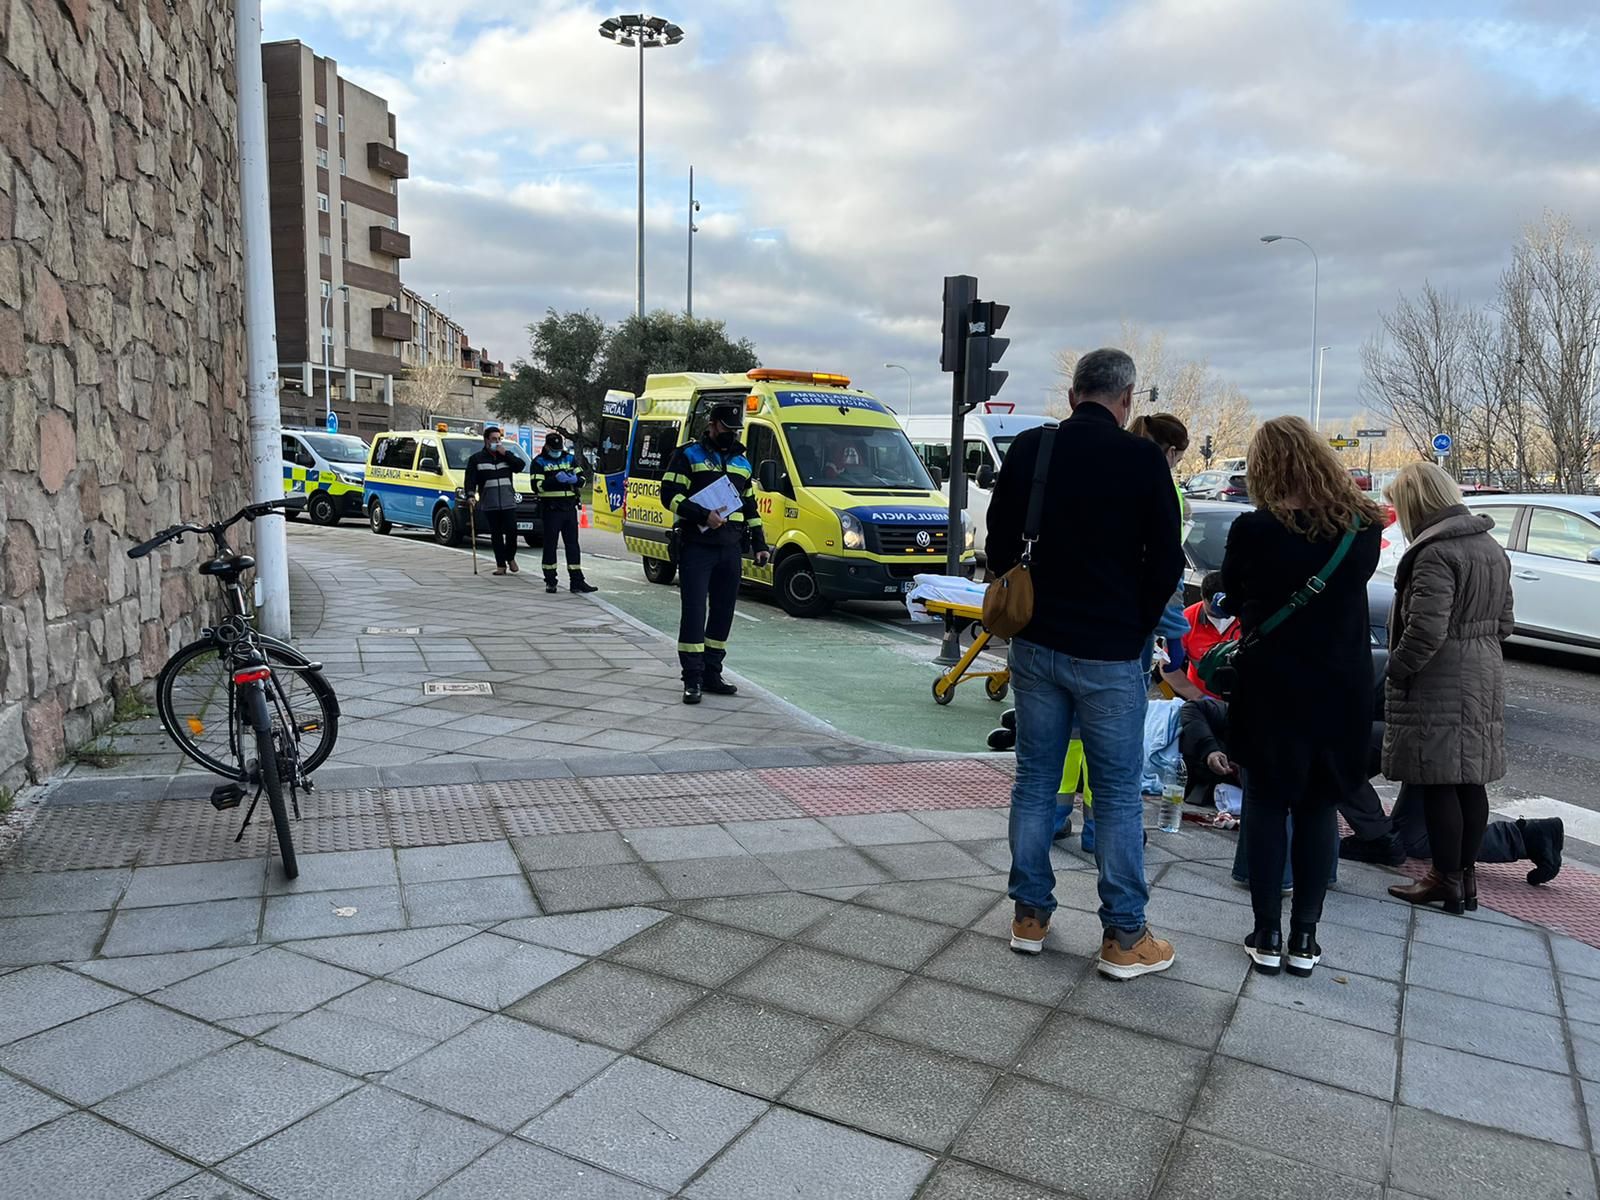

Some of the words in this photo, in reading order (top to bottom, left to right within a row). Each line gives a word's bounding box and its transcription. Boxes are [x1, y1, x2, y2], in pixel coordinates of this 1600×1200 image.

[790, 392, 869, 403] AMBULANCIA
[794, 397, 873, 409] ASISTENCIAL
[609, 493, 622, 507] 112
[759, 497, 772, 514] 112
[627, 504, 663, 524] anitarias
